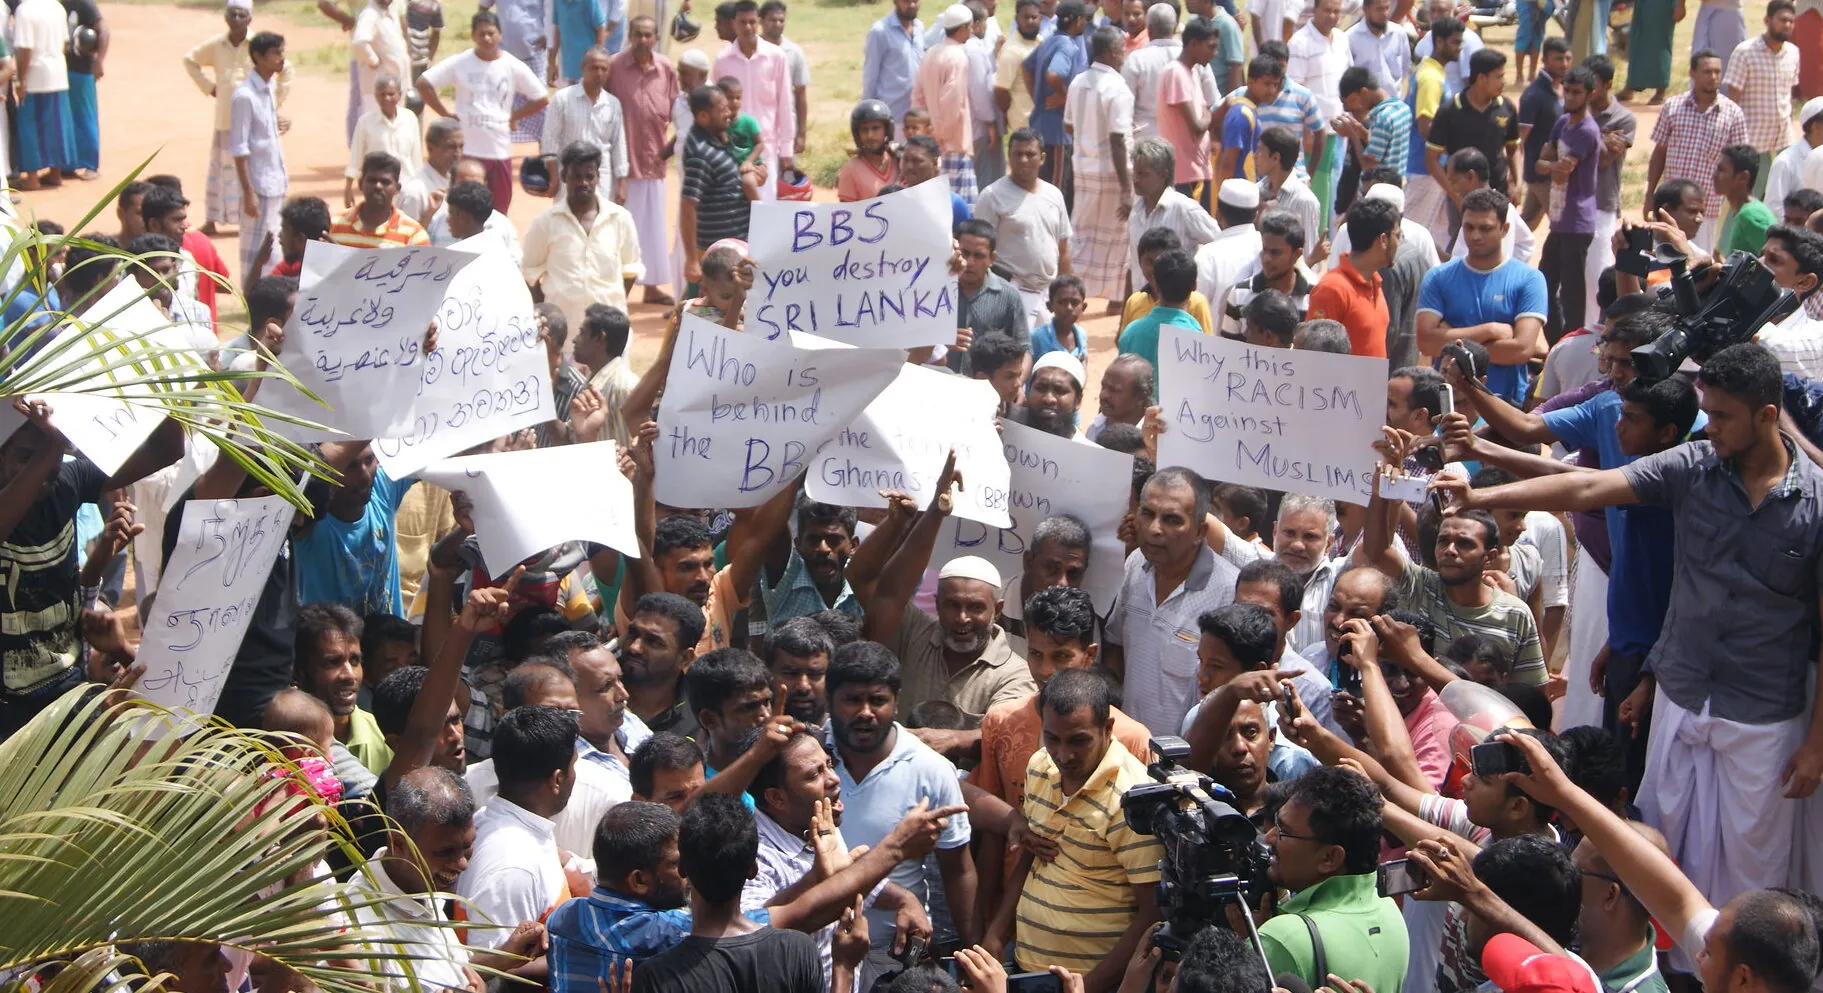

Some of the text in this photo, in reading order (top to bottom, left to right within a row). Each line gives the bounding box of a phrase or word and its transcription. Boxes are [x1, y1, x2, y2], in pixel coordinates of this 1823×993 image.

[791, 201, 889, 253] BBS
[762, 249, 931, 301] you destroy
[756, 300, 818, 341] SRI
[687, 330, 820, 388] Who is
[1175, 336, 1295, 383] Why this
[711, 388, 822, 425] behind
[1226, 371, 1363, 420] RACISM
[668, 426, 713, 460] the
[1176, 397, 1289, 443] Against
[1236, 440, 1373, 496] MUSLIMS
